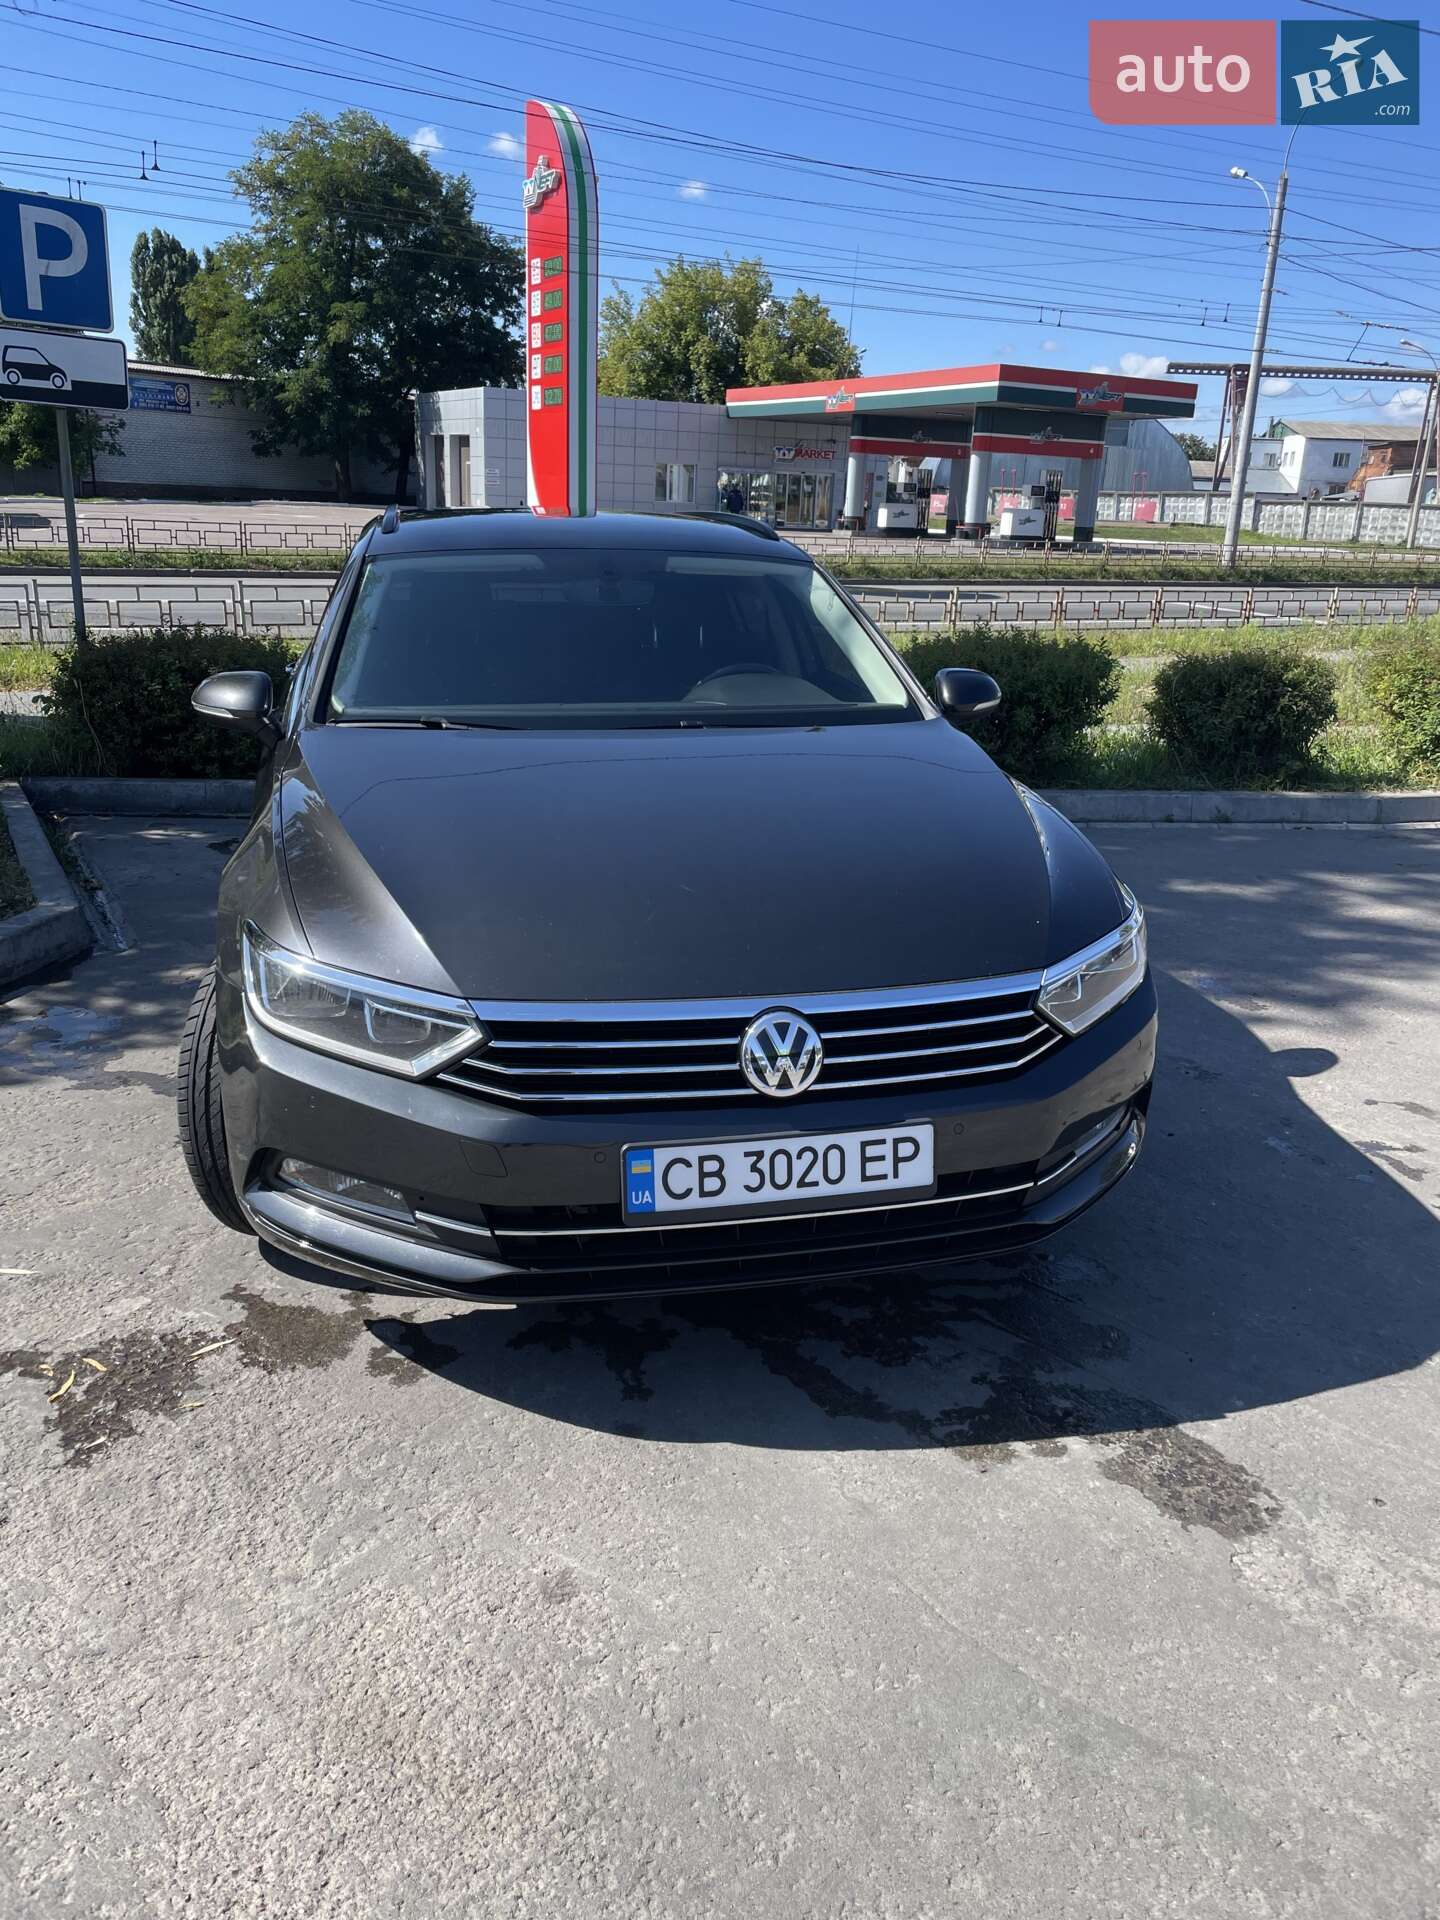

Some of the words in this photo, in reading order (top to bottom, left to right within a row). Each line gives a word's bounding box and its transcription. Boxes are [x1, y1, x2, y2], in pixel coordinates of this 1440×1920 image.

[18, 203, 89, 311] P
[631, 1190, 653, 1206] UA
[661, 1154, 727, 1201] CB
[742, 1143, 846, 1194] 3020
[859, 1136, 921, 1184] EP
